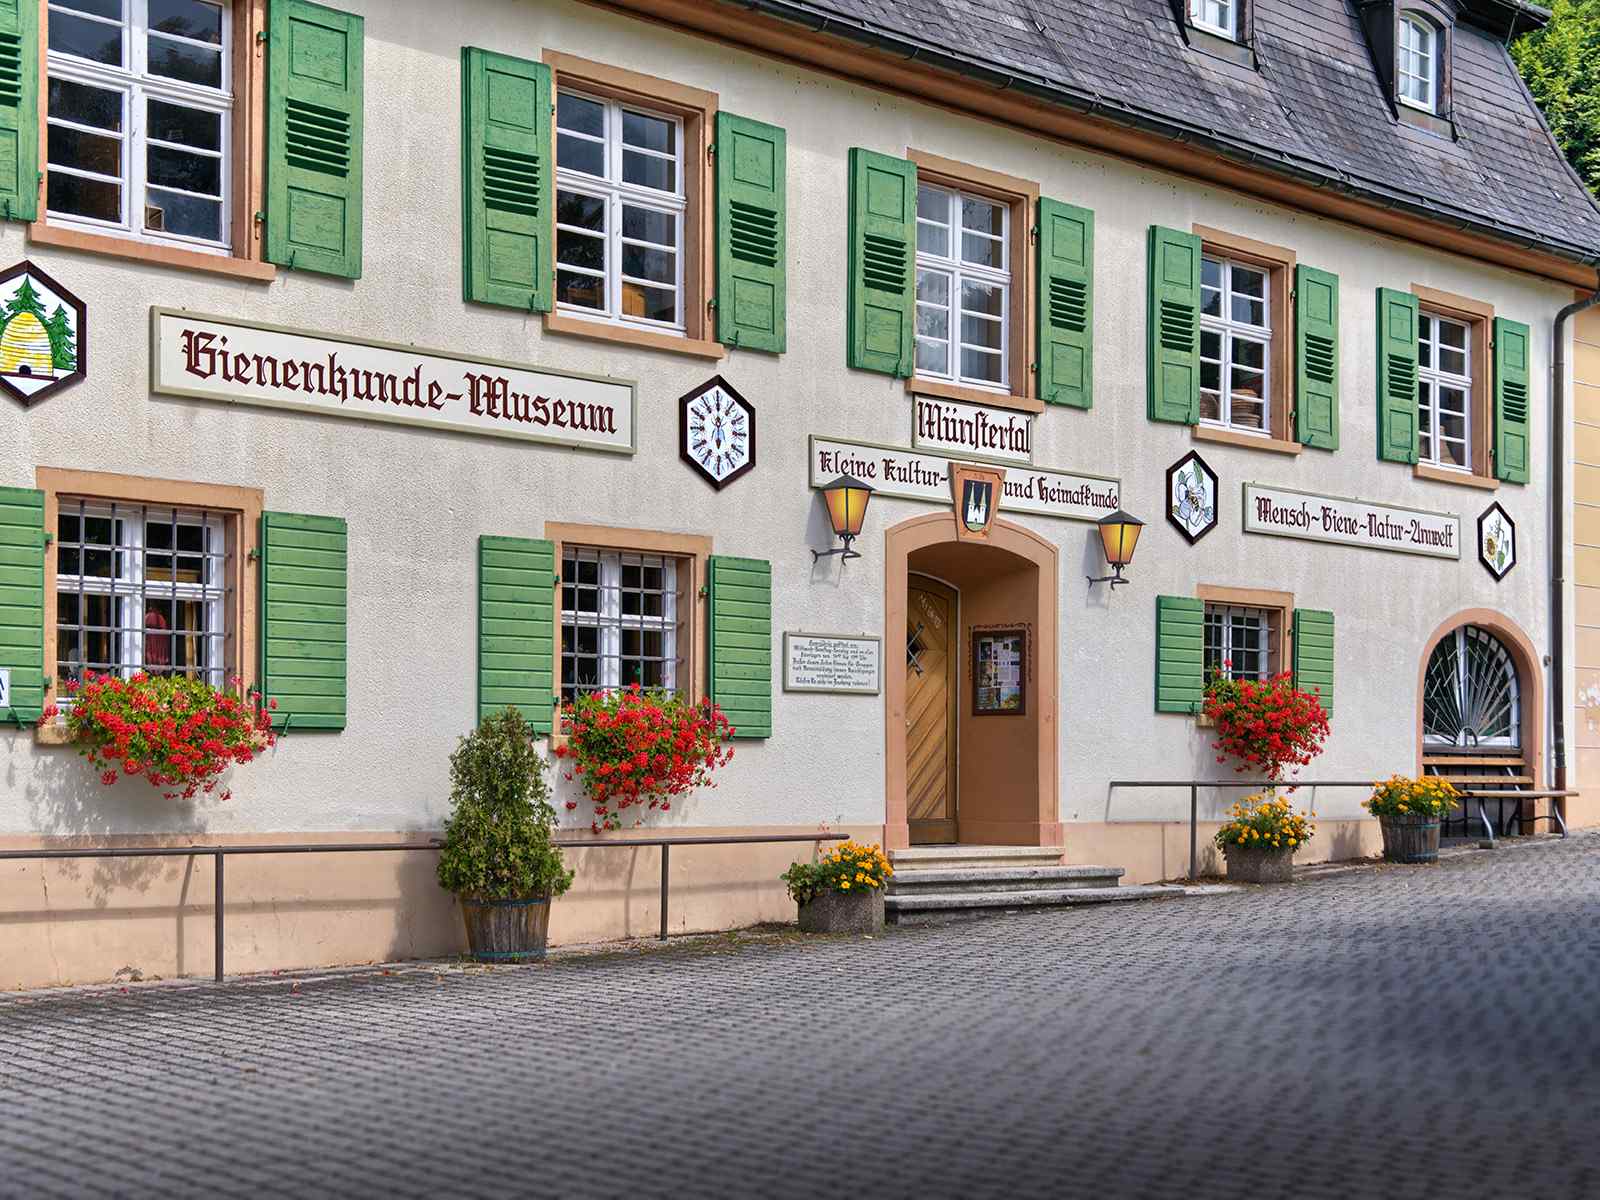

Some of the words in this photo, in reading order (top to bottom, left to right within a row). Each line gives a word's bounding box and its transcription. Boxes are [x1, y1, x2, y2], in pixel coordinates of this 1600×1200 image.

[181, 329, 617, 434] Bienenkunde-Museum
[819, 451, 877, 479] Kleine
[882, 458, 948, 488] Kultur-
[1003, 476, 1033, 498] und
[1037, 478, 1118, 510] Heimatkunde
